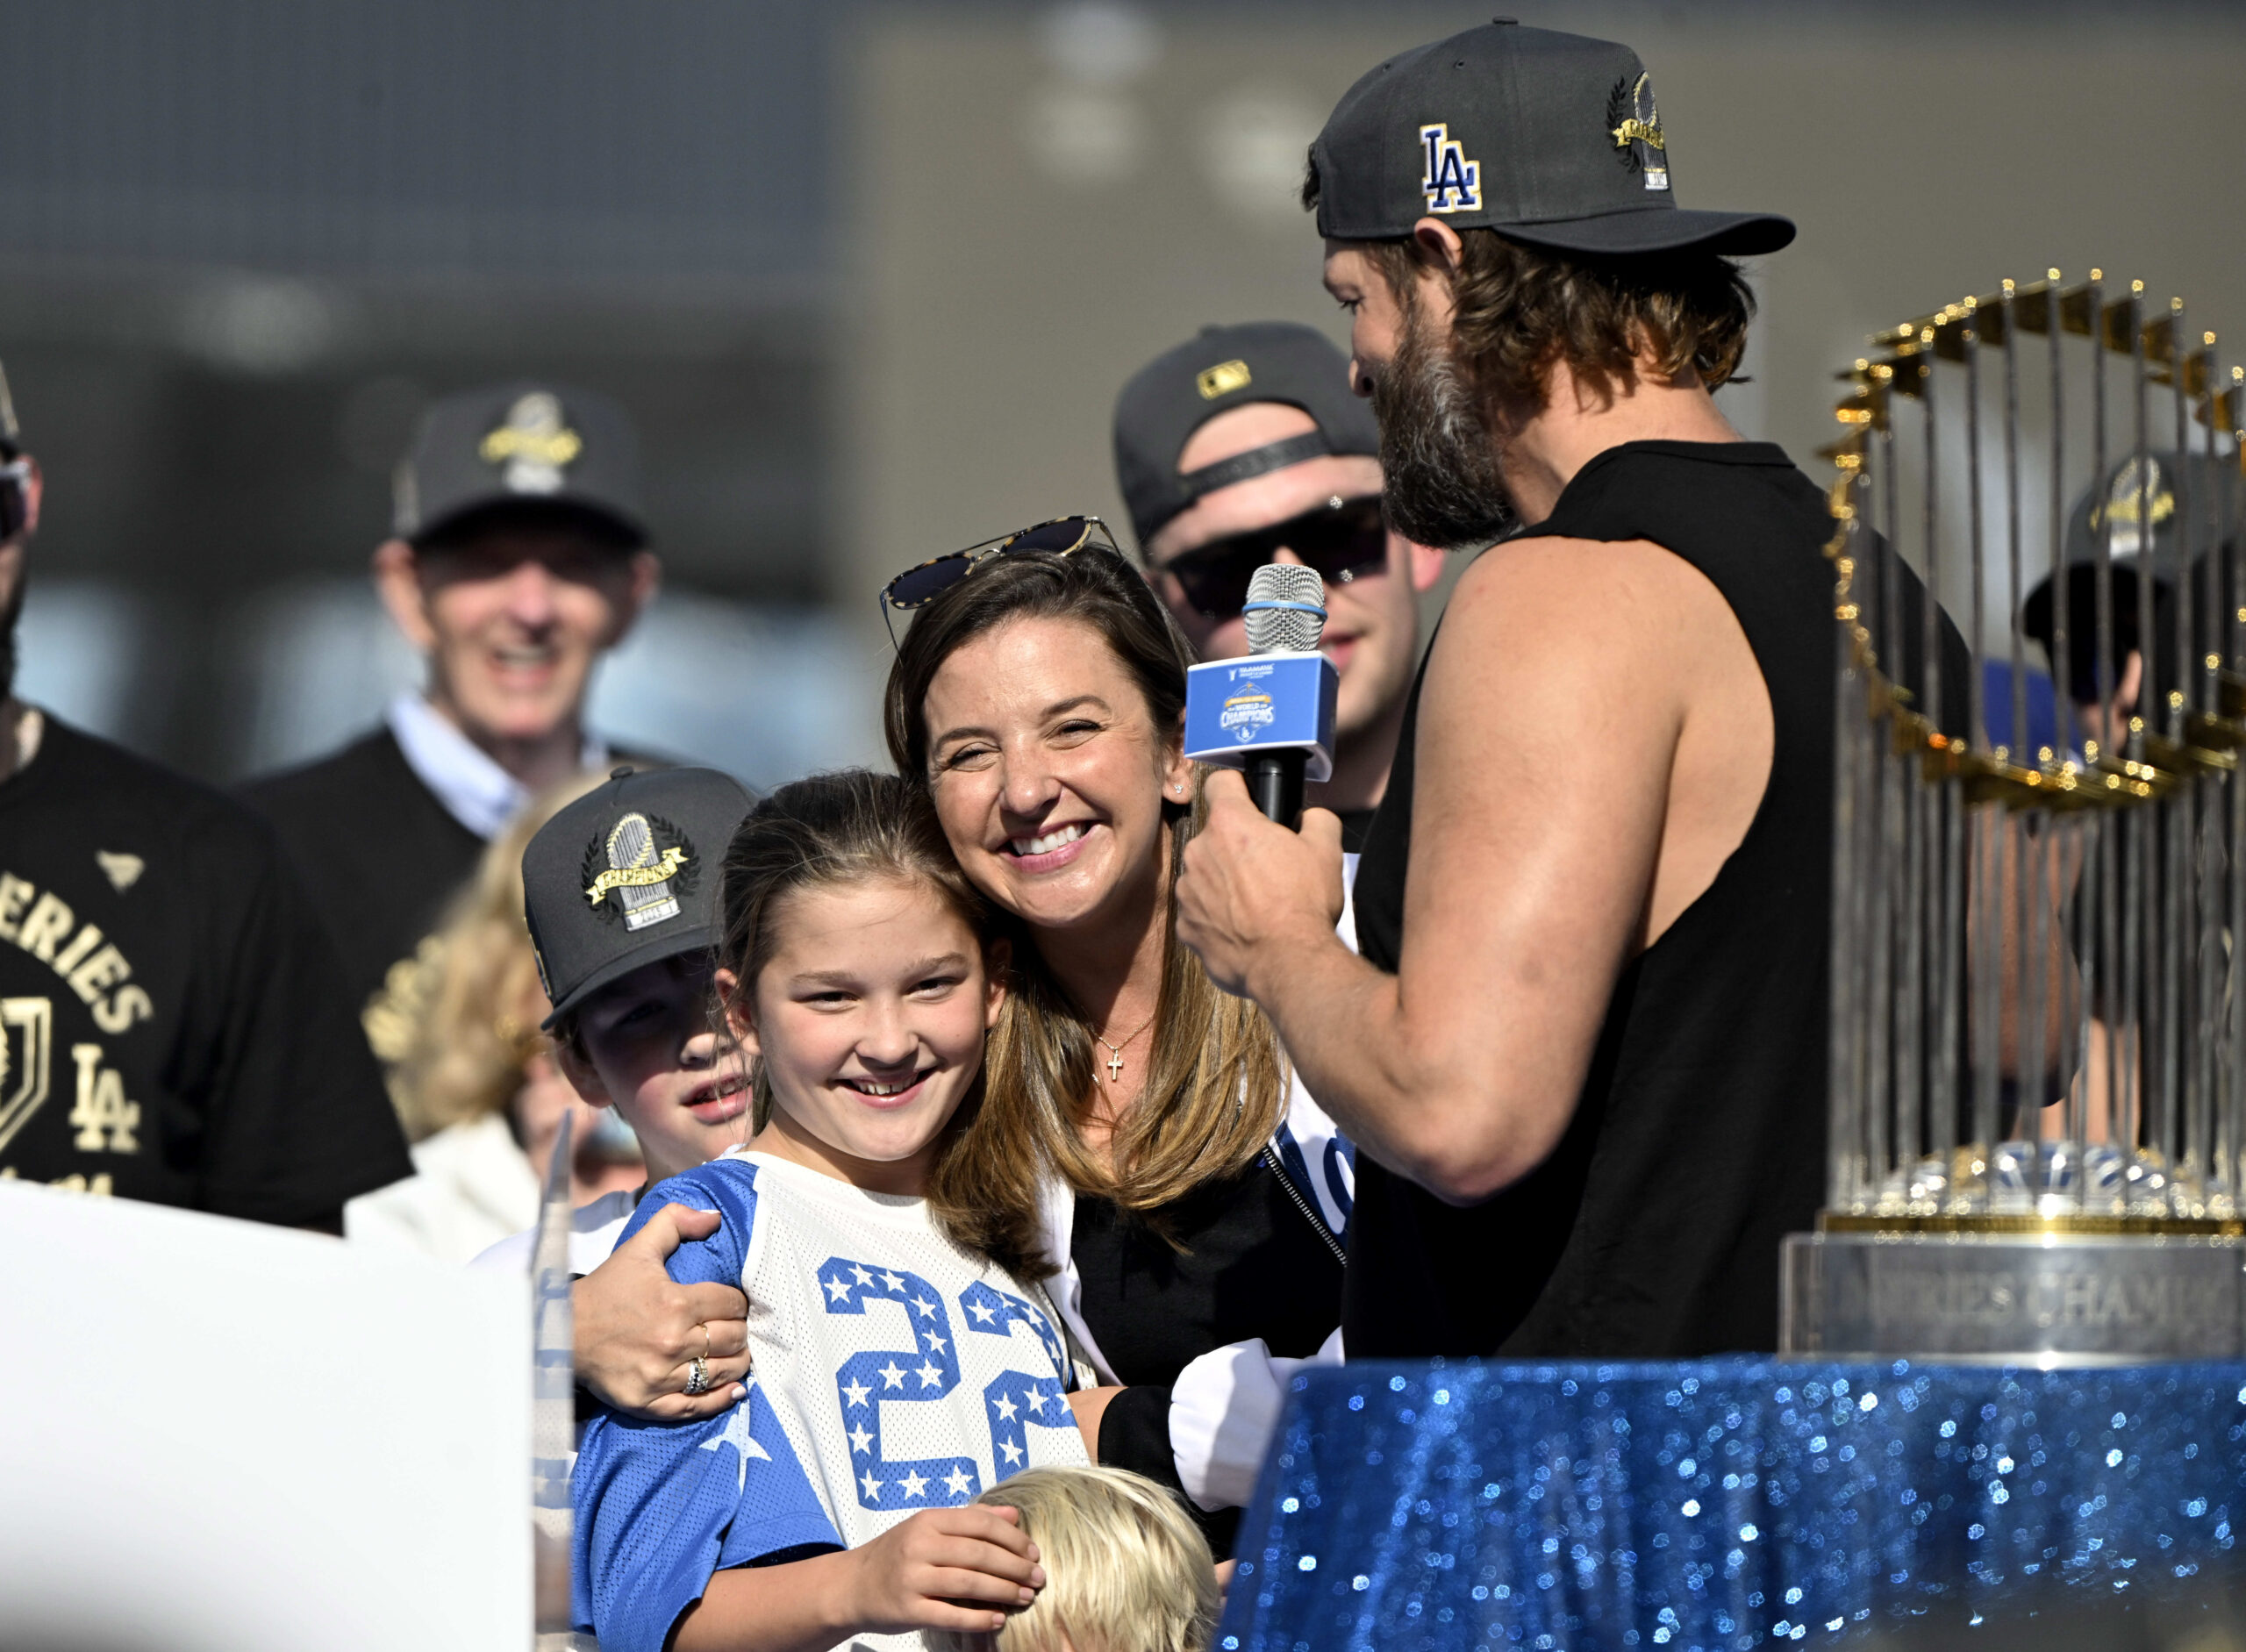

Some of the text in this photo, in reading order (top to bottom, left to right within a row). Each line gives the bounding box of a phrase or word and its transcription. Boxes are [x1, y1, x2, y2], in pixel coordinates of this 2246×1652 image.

[1420, 123, 1483, 213] LA
[1220, 706, 1274, 728] CHAMPIONS
[1236, 702, 1260, 712] WORLD
[69, 1043, 140, 1153] LA
